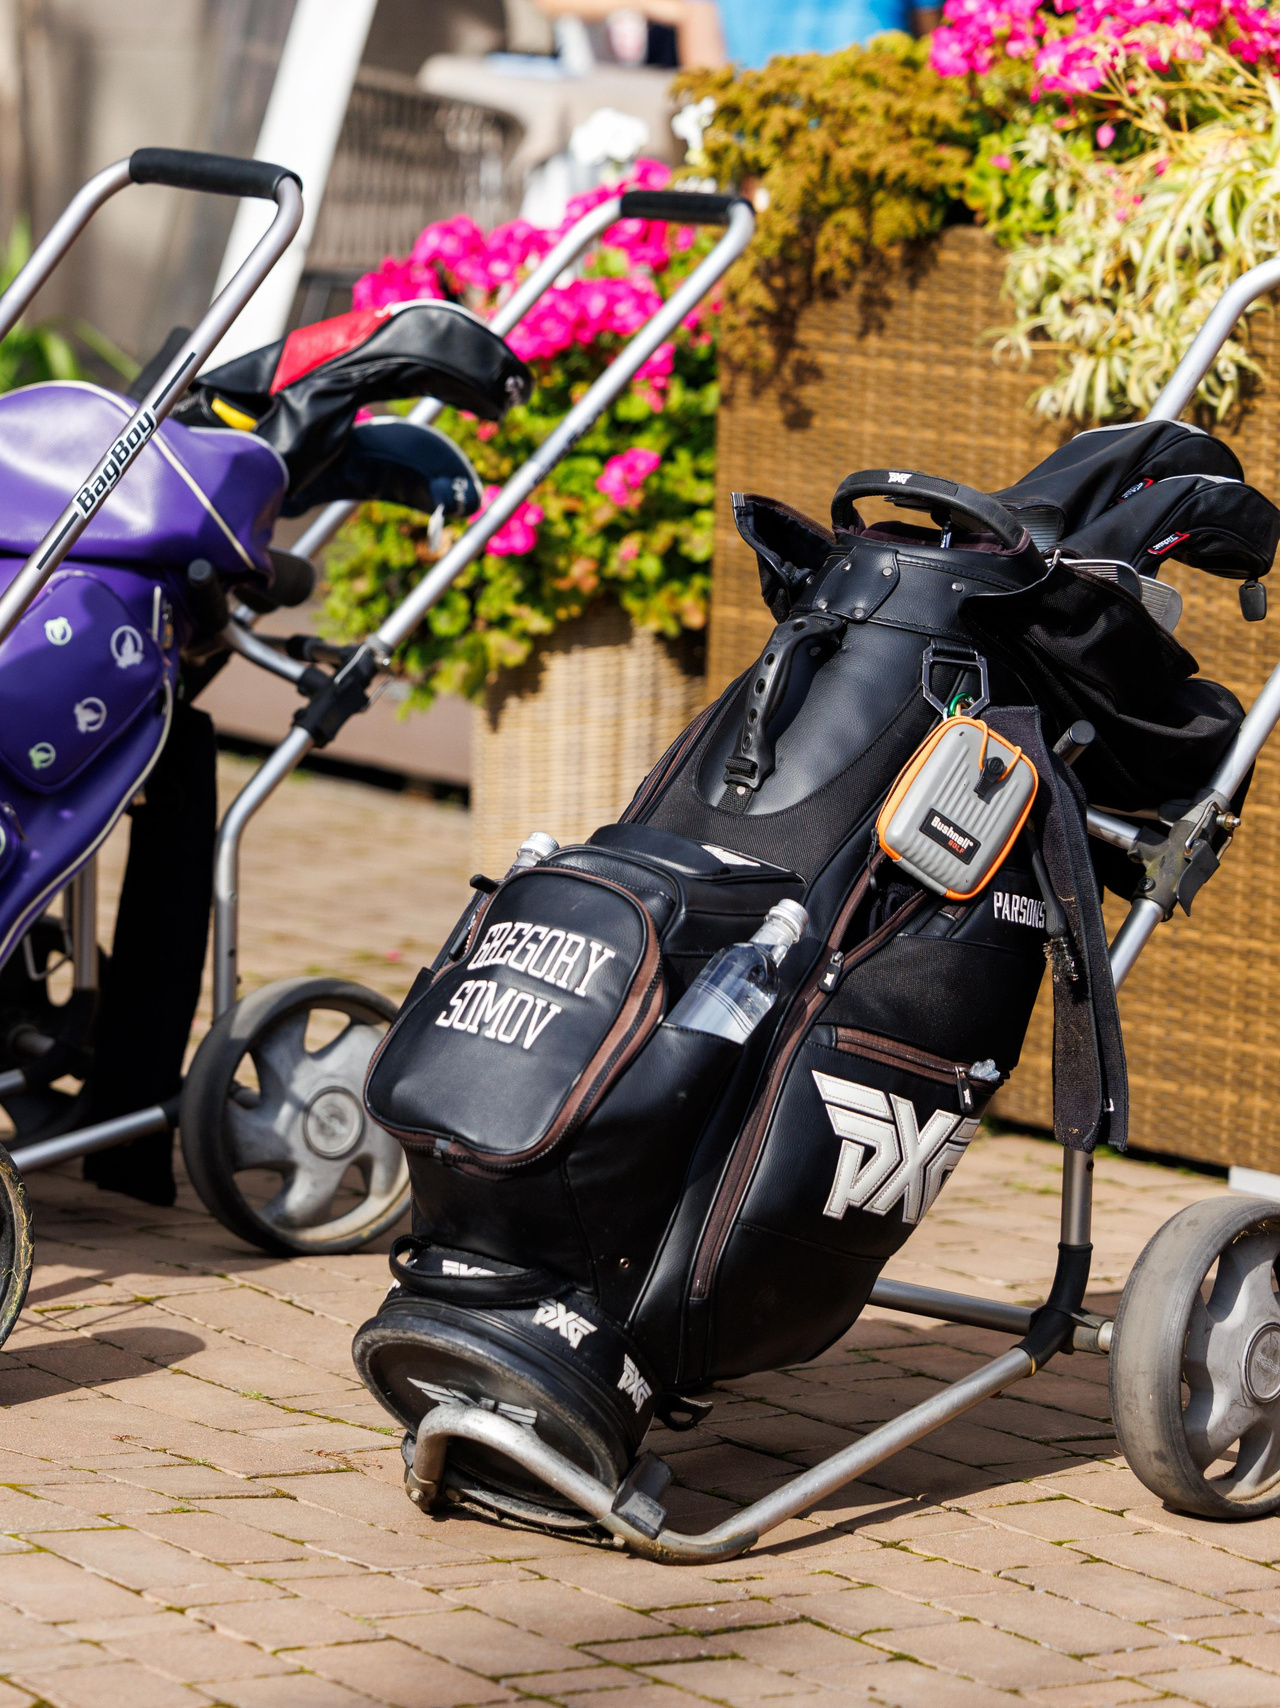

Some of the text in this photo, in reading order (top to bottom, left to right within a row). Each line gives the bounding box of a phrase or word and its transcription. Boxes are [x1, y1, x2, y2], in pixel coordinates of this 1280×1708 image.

[74, 409, 157, 517] BagBoy
[931, 815, 972, 850] Bushnell
[947, 839, 966, 854] GOLF
[993, 891, 1046, 929] PARSONS
[467, 921, 616, 998] GREGORY
[435, 979, 563, 1050] SOMOV
[531, 1299, 599, 1350] PXG
[616, 1353, 653, 1414] PXG
